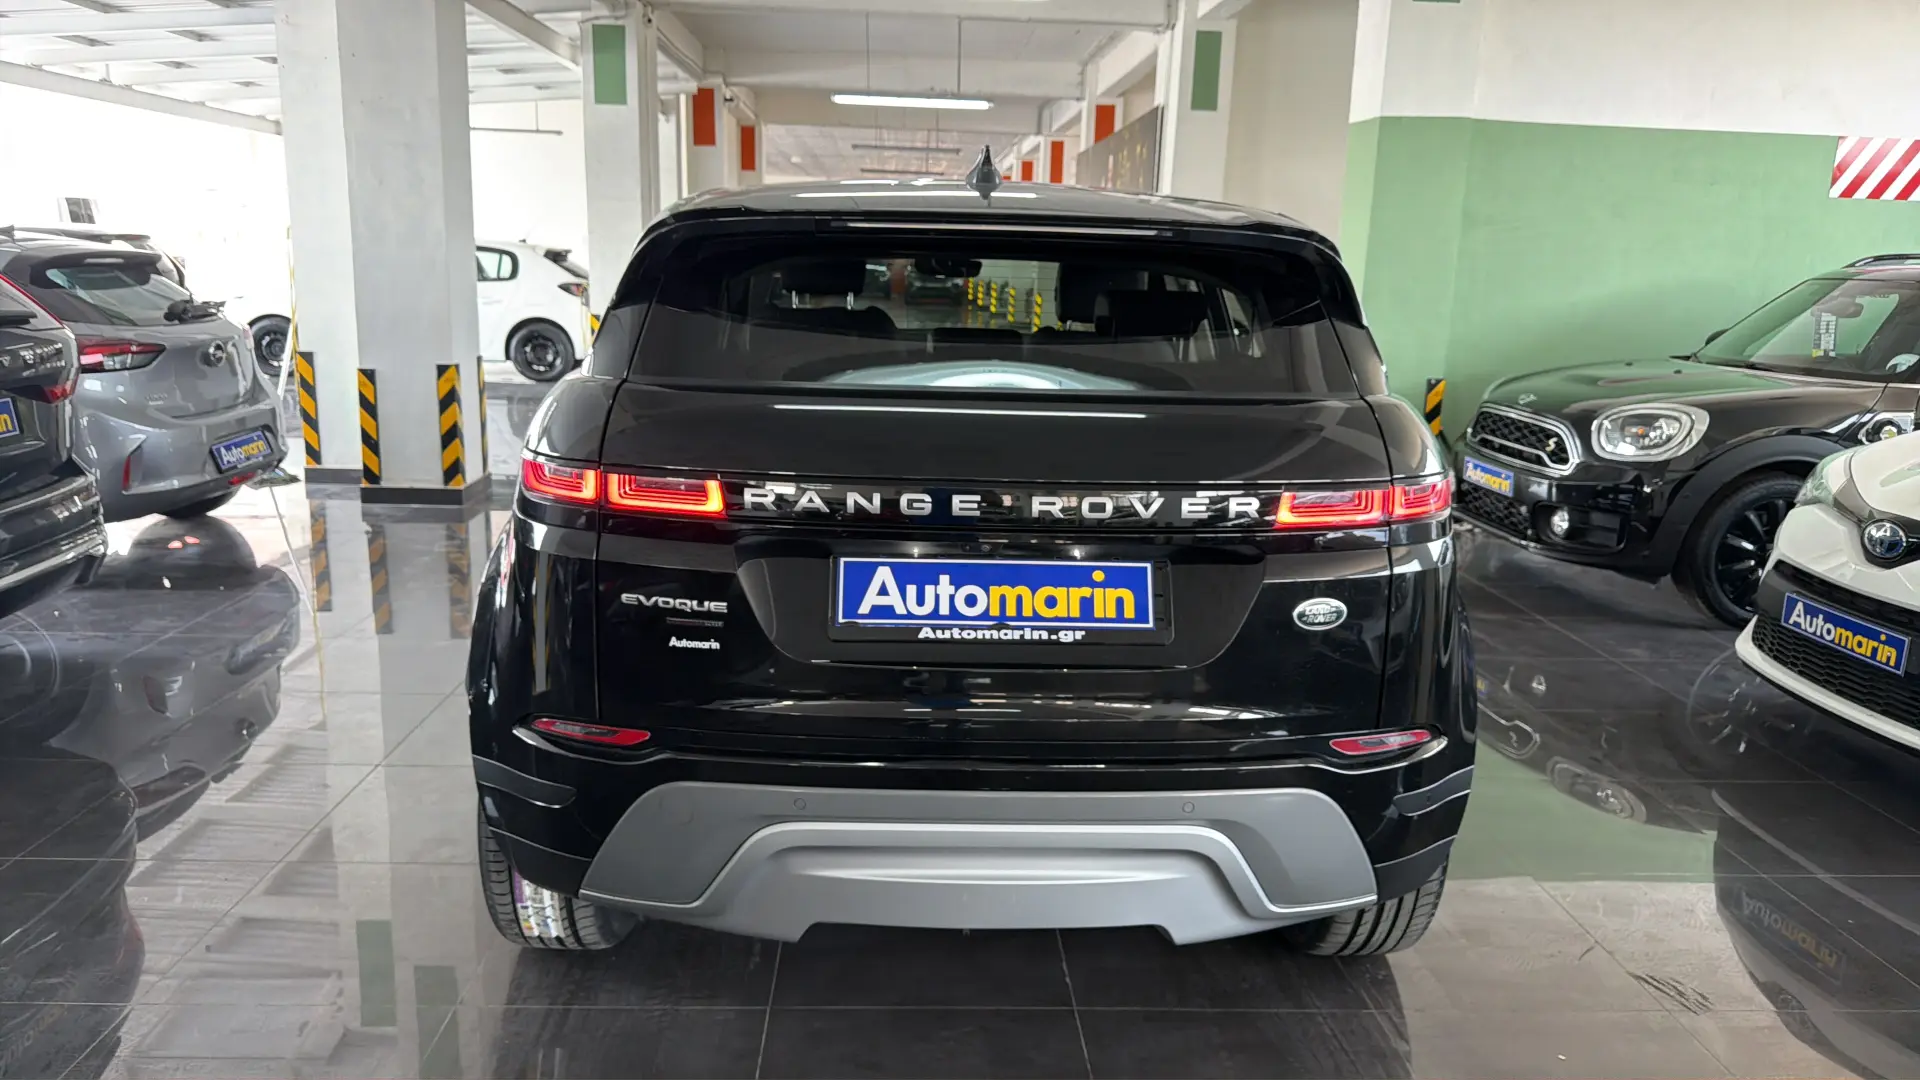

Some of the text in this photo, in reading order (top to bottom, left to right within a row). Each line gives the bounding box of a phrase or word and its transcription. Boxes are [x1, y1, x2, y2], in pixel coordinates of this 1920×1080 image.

[743, 487, 1261, 519] RANGE ROVER
[620, 593, 728, 613] EVOQUE
[856, 565, 1135, 619] Automarin
[668, 636, 720, 650] Automarin
[917, 626, 1086, 643] Automarin.gr
[1788, 601, 1897, 667] Automarin
